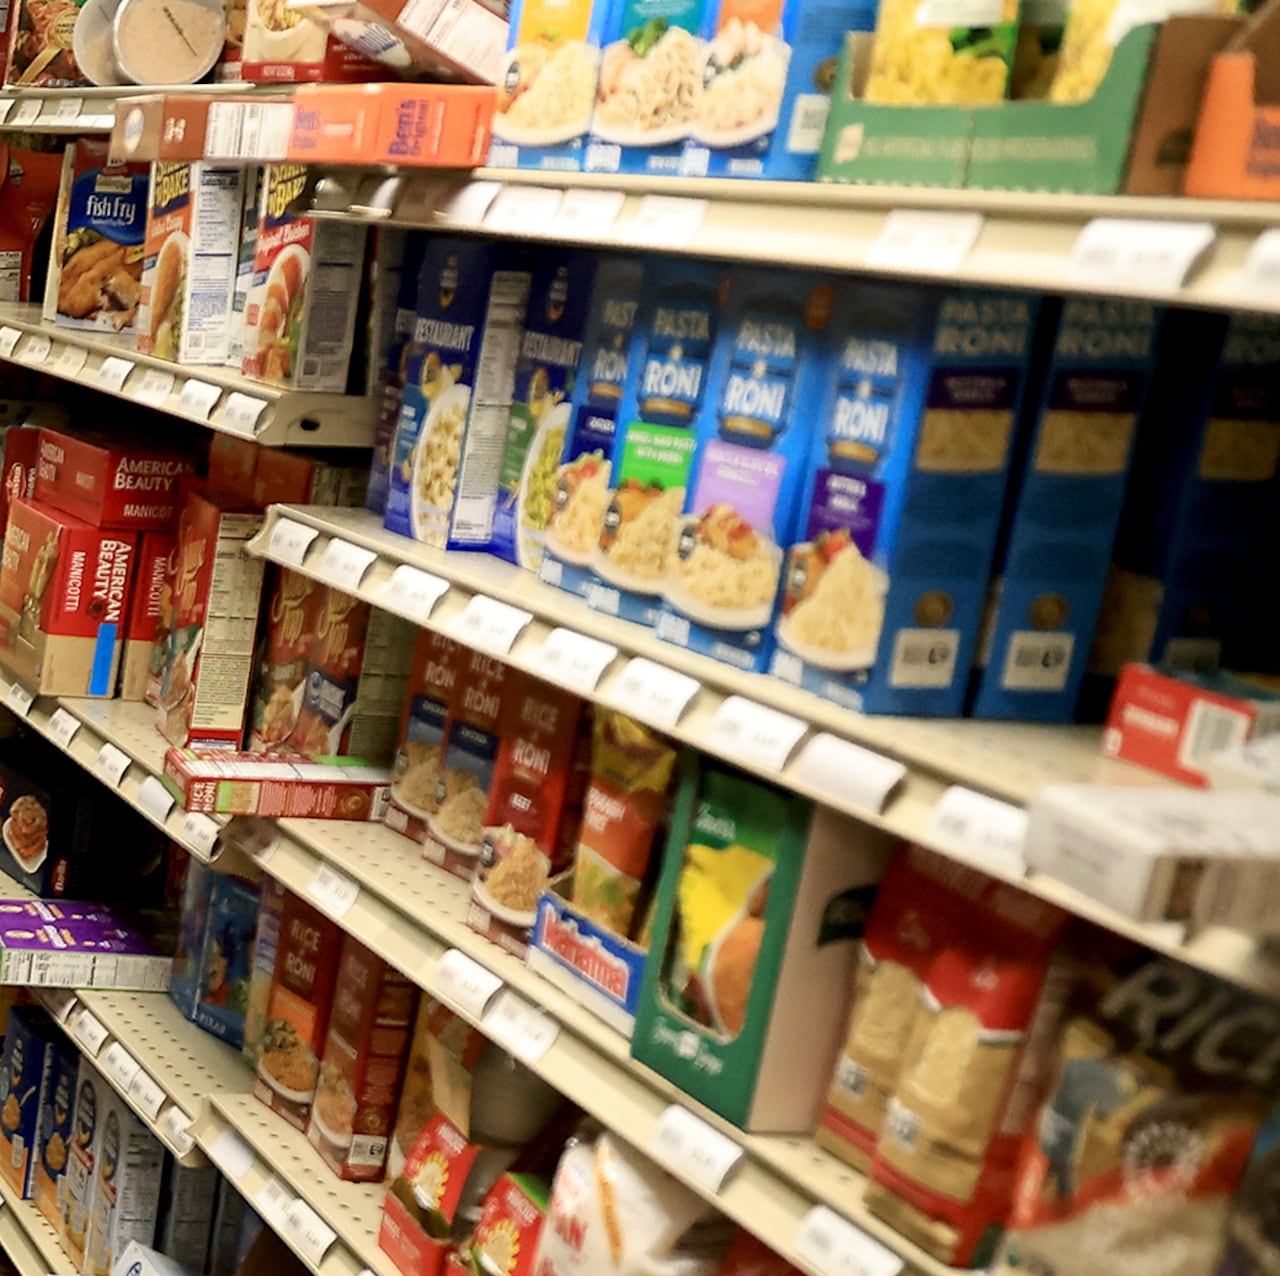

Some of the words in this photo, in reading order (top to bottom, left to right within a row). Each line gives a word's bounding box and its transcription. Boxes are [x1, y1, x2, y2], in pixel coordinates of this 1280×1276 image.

[86, 195, 112, 219] fish
[112, 199, 137, 225] fry
[643, 357, 703, 402] RONI
[725, 374, 788, 422] RONI
[835, 396, 889, 446] RONI
[114, 472, 173, 491] BEAUTY
[93, 538, 118, 601] BEAUTY
[104, 540, 132, 622] AMERICAN
[512, 738, 551, 776] RONI
